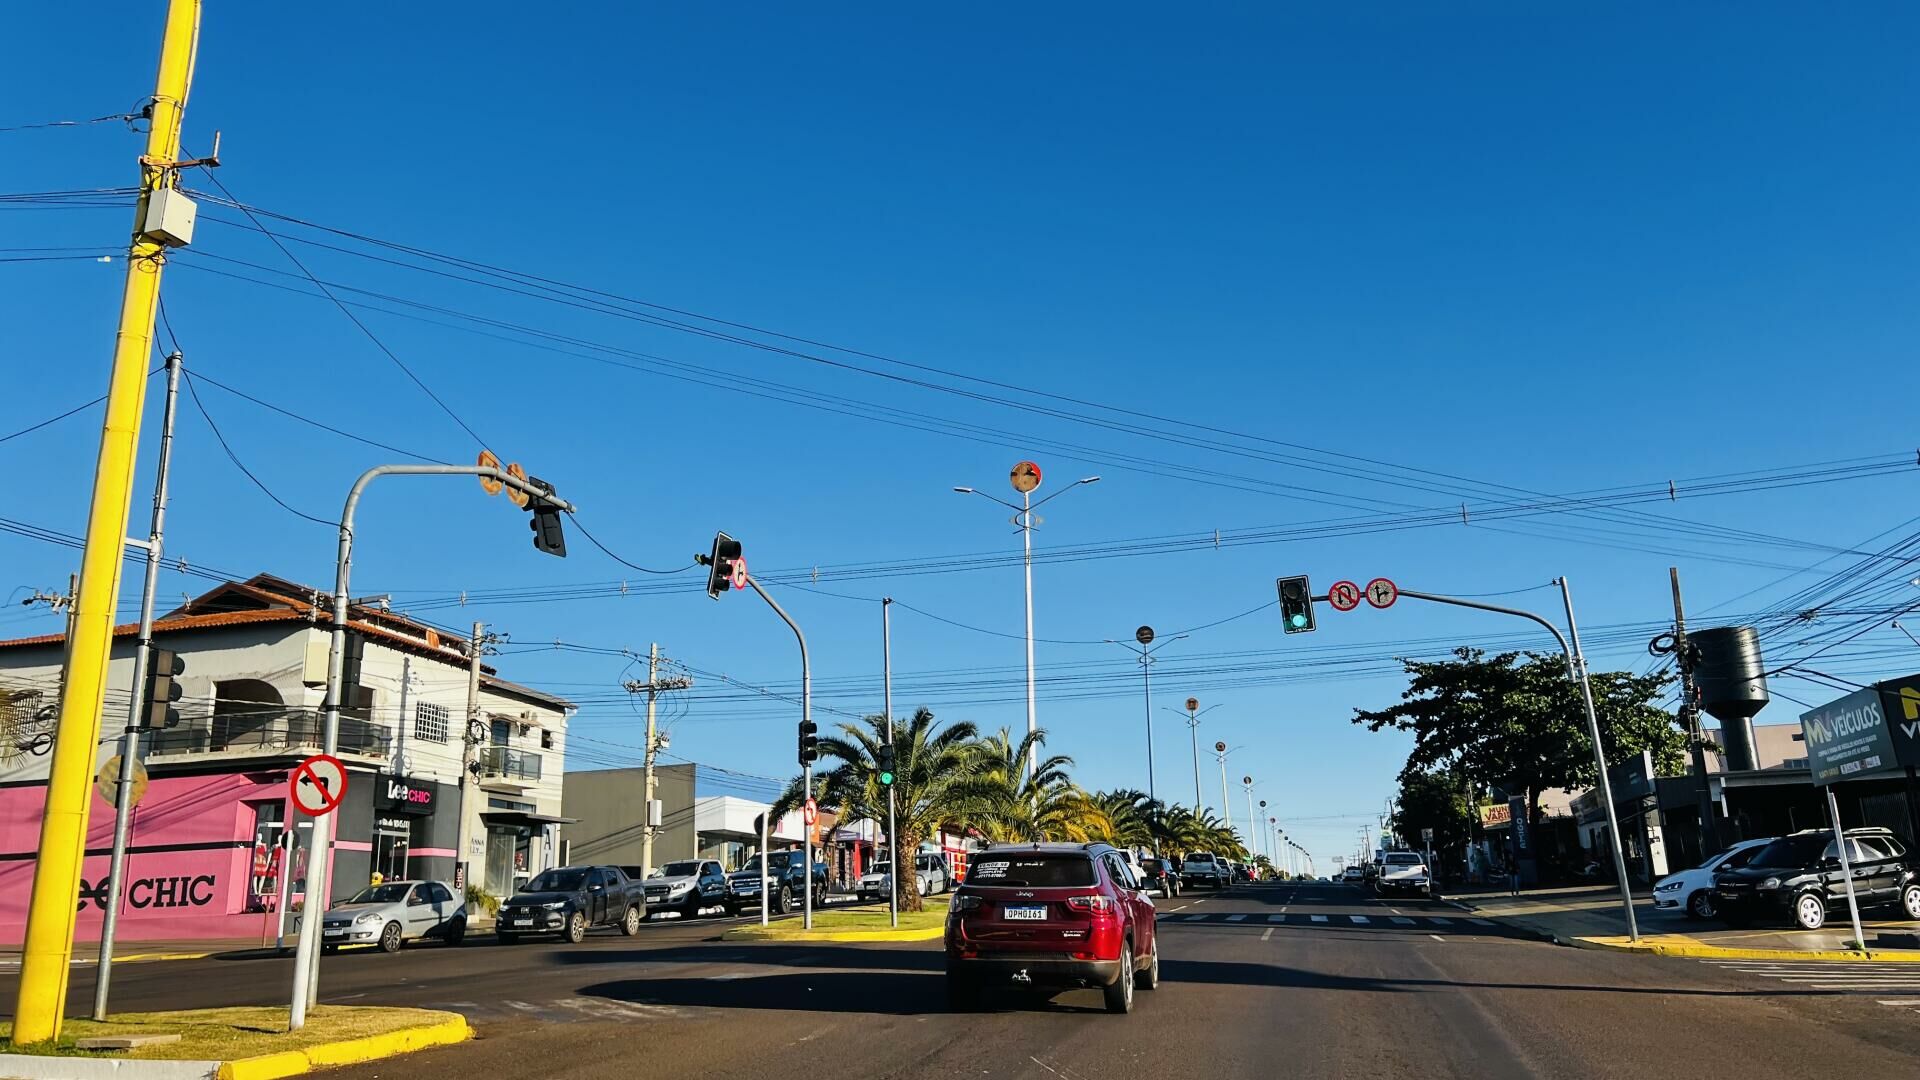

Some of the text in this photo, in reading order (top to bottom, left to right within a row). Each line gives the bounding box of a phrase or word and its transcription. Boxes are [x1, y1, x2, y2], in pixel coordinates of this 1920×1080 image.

[1831, 702, 1881, 738] VEÍCULOS
[387, 779, 431, 804] Lee CHIC
[128, 875, 216, 909] CHIC
